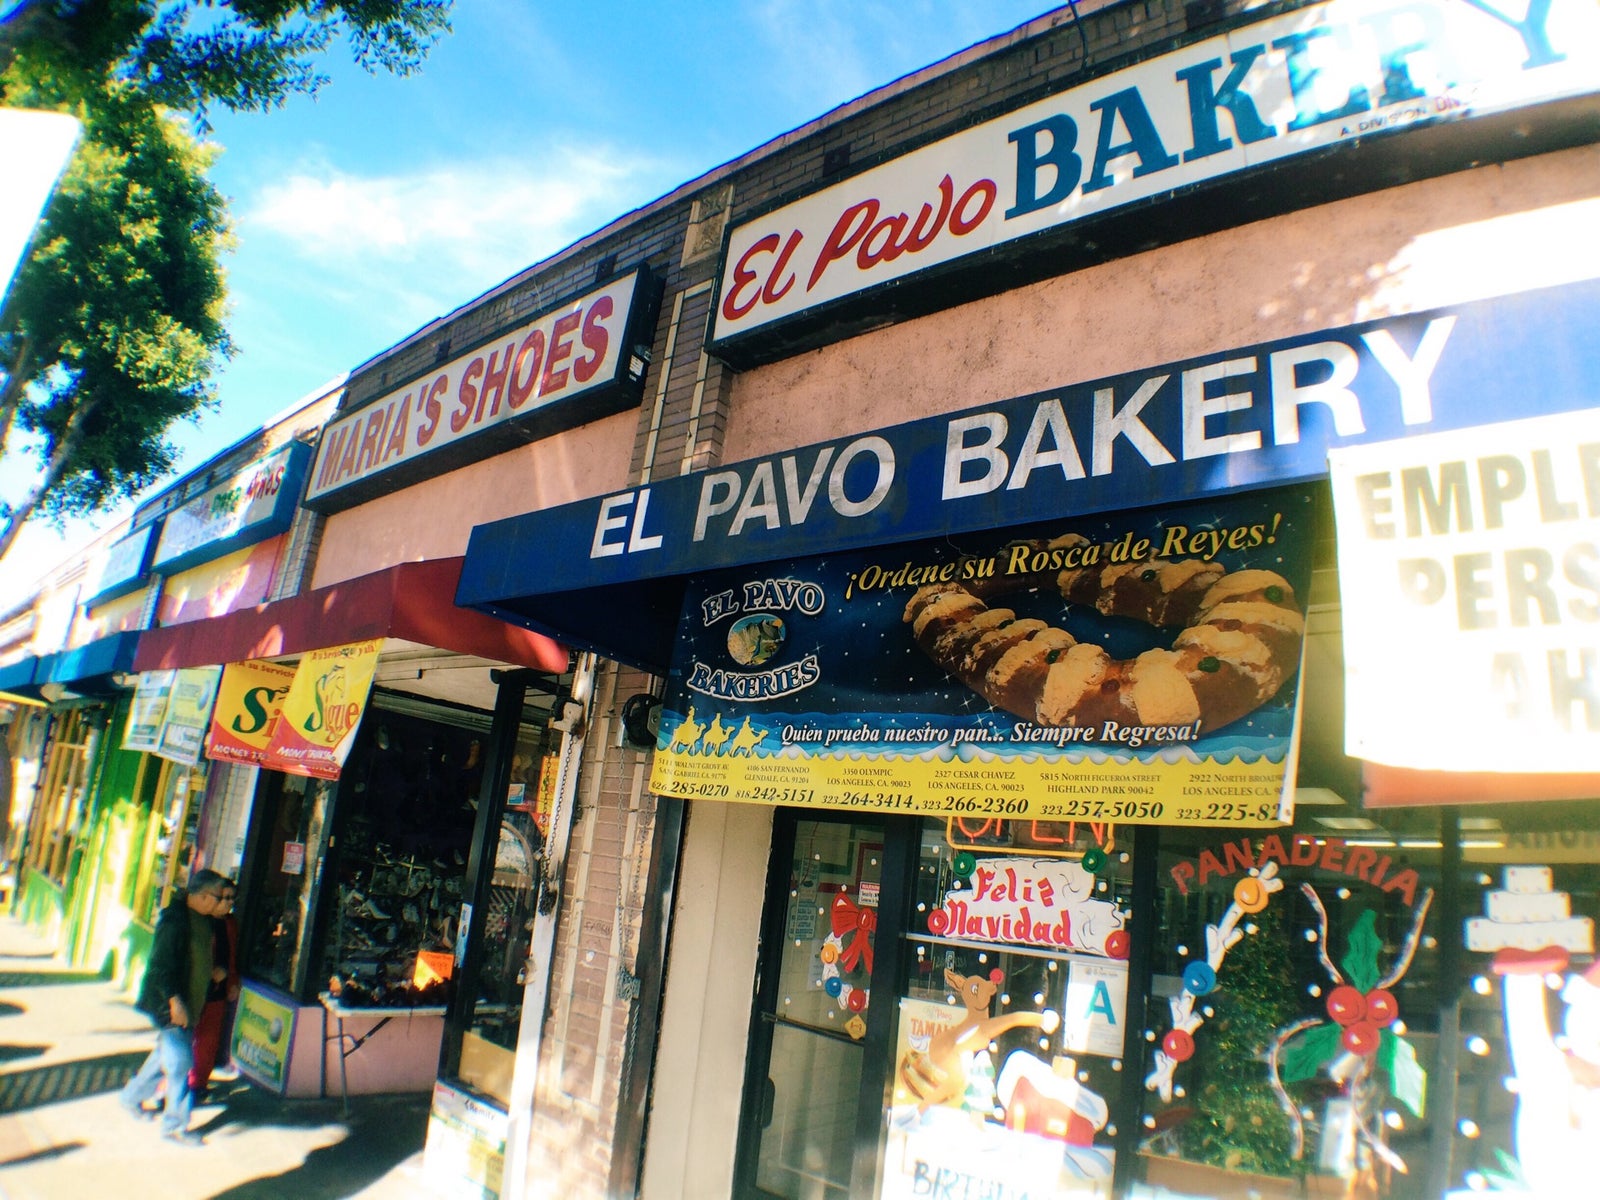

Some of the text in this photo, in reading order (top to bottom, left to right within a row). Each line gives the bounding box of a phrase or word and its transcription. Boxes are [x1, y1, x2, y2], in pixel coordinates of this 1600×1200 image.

[1358, 106, 1428, 132] DIVISION
[722, 0, 1567, 320] El Pavo BAKERY
[317, 295, 614, 491] MARIA'S SHOES
[590, 315, 1457, 559] EL PAVO BAKERY
[844, 513, 1282, 600] ¡Ordene su Rosca de Reyes!
[702, 578, 825, 626] EL PAVO
[686, 654, 820, 702] BAKERIES
[304, 673, 360, 742] Sigue
[782, 719, 1200, 747] Quien prueba nuestro pan... Siempre Regresa!
[773, 766, 811, 774] FERNANDO
[842, 768, 893, 777] 3350 OLYMPIC
[890, 780, 911, 788] 90023
[928, 781, 942, 789] LOS
[943, 782, 983, 791] ANGELES,
[1001, 783, 1025, 792] 90023
[935, 770, 1015, 780] 2327 CESAR CHAVEZ
[1040, 773, 1161, 782] 5815 NORTH FIGUEROA STREET
[1189, 774, 1211, 783] 2922
[1214, 774, 1247, 783] NORTH
[1047, 784, 1154, 795] HIGHLAND PARK 90042
[1183, 787, 1202, 796] LOS
[1204, 787, 1252, 796] ANGELES
[973, 866, 1055, 907] Feliz
[1171, 833, 1420, 907] PANADERIA
[945, 899, 1073, 947] Navidad
[1083, 980, 1117, 1026] A
